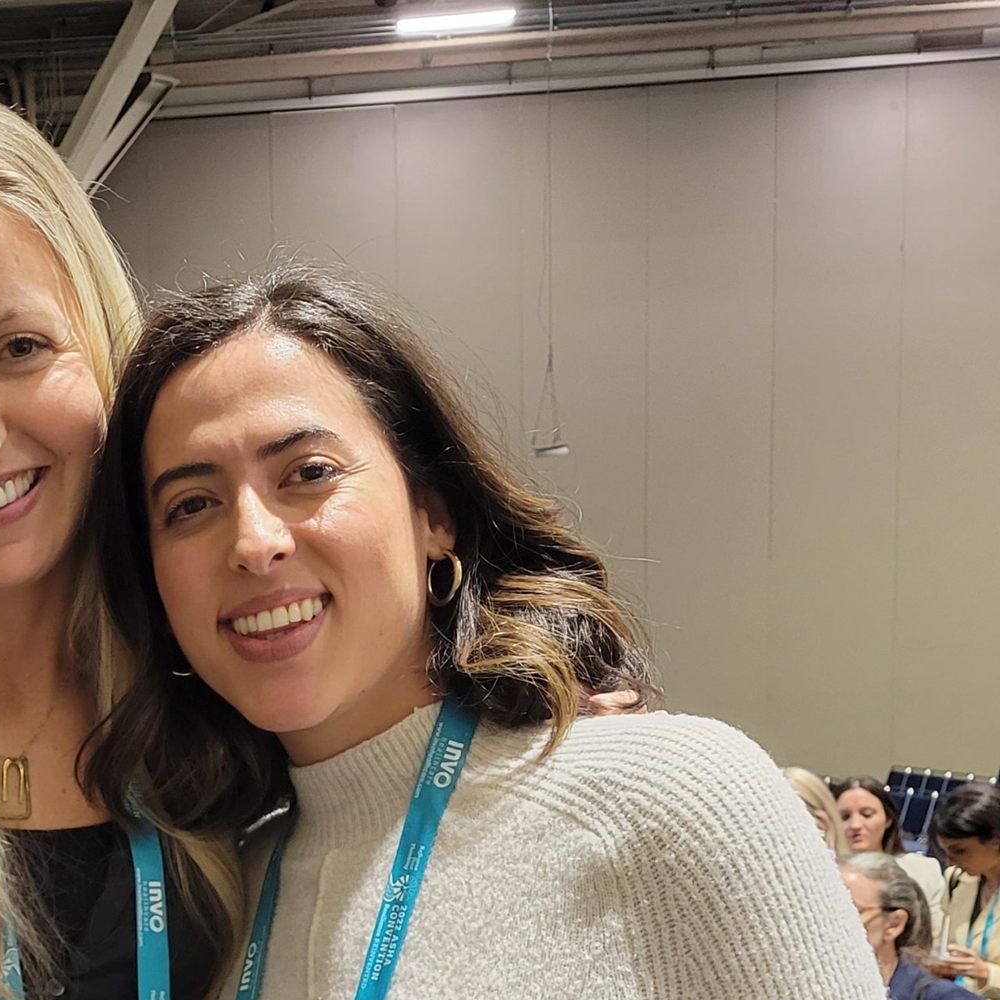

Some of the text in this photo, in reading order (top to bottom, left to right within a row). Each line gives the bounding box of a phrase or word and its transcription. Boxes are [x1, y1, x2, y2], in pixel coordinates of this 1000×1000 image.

[371, 904, 399, 981] CONVENTION
[384, 905, 407, 966] 2022 ASHA
